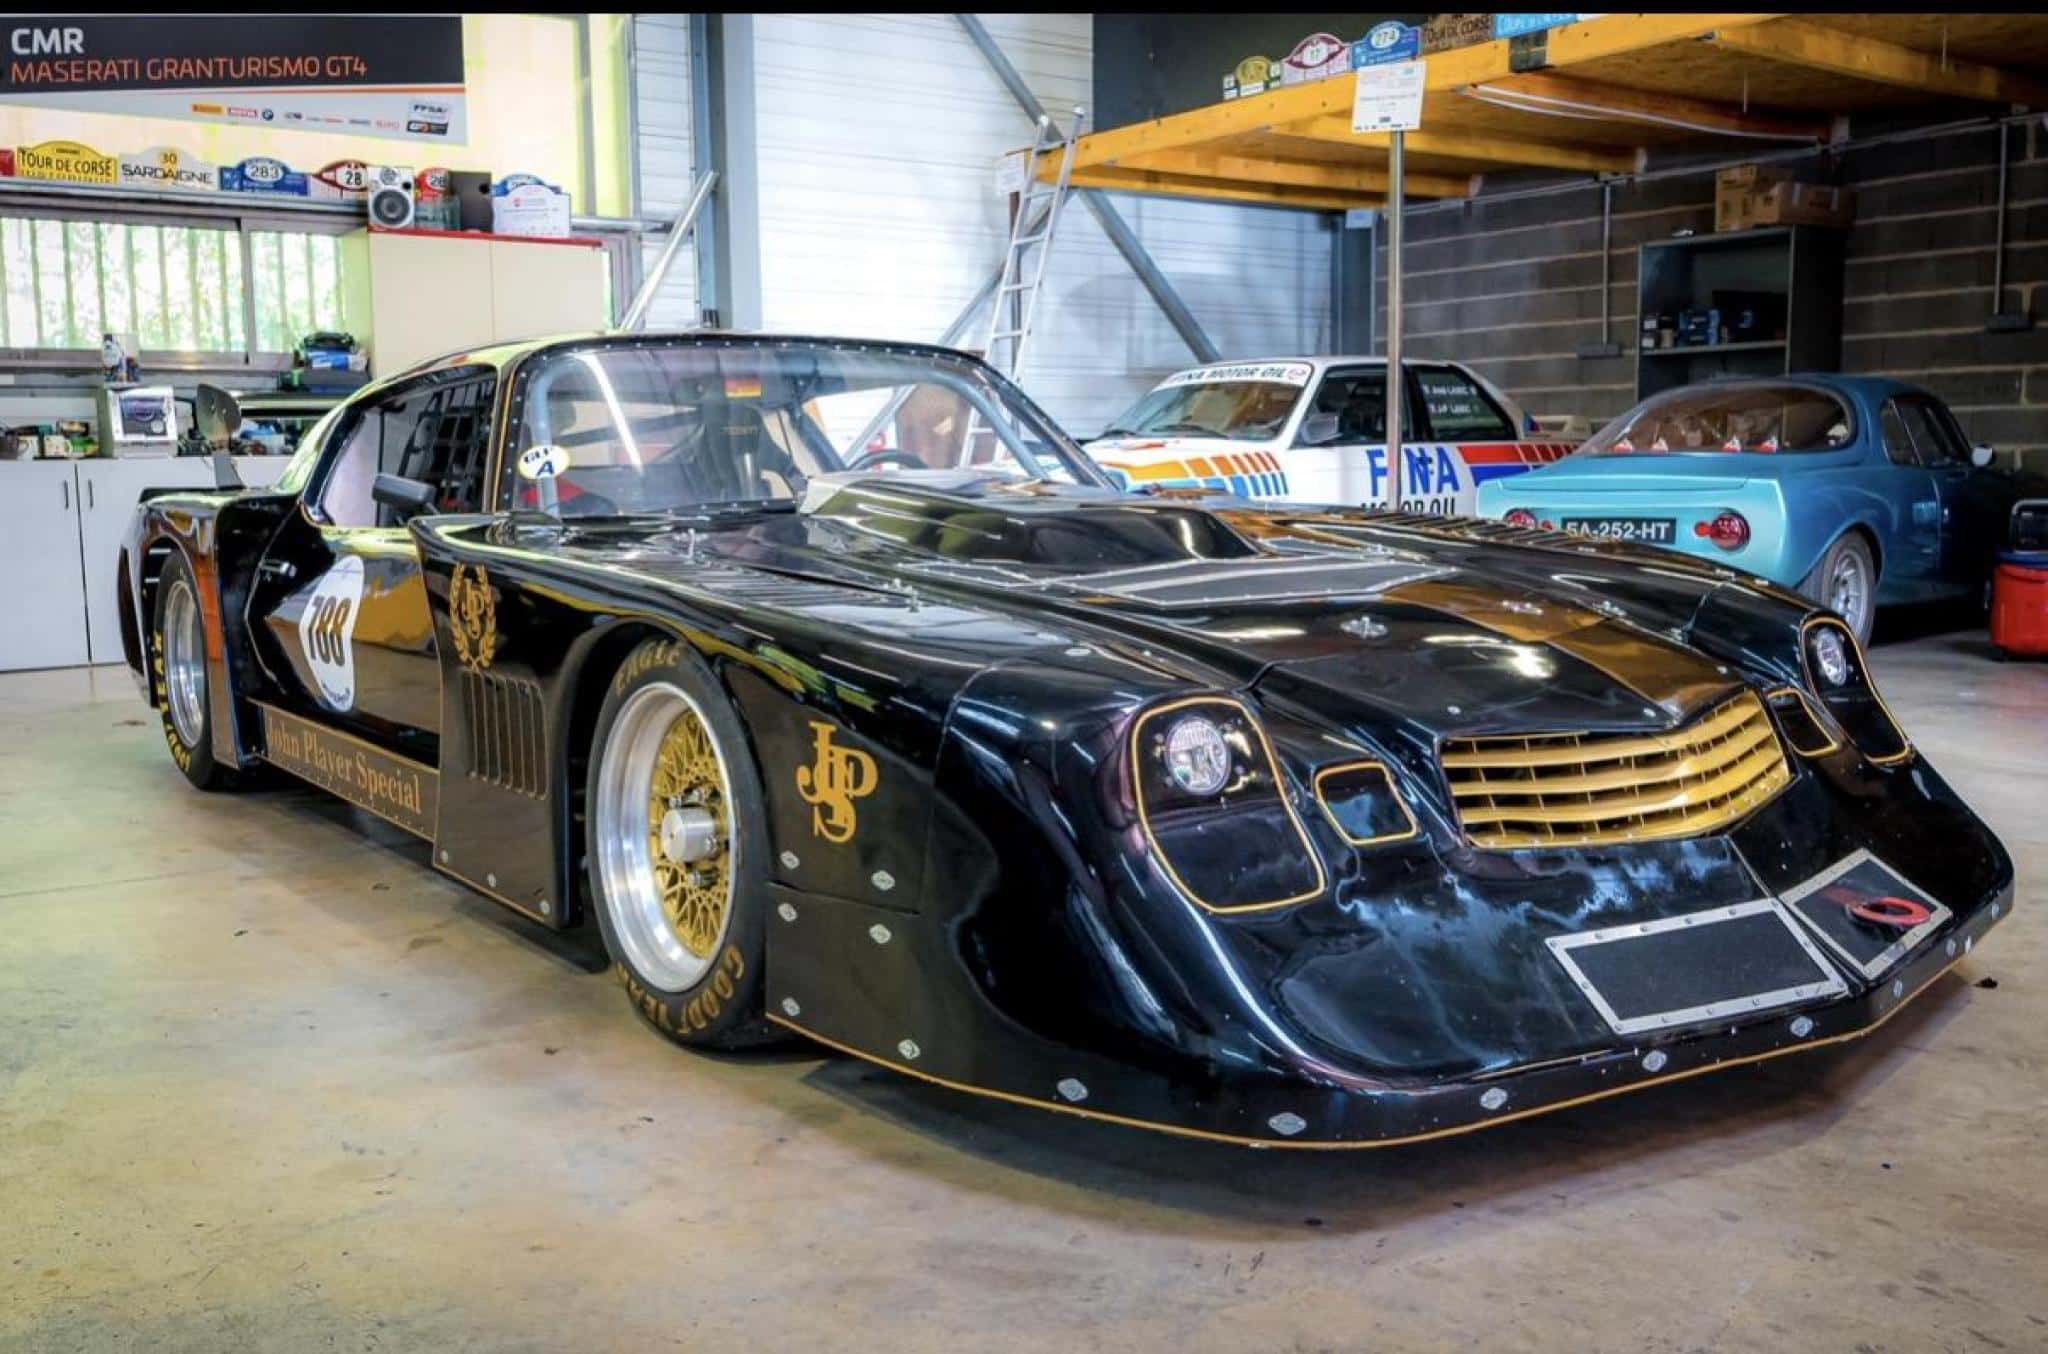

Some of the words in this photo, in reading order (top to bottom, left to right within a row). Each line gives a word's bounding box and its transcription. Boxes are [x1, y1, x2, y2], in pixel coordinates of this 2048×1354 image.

[11, 28, 84, 55] CMR
[11, 59, 139, 83] MASERATI
[146, 56, 320, 80] GRANTURISMO
[326, 55, 367, 77] GT4
[20, 149, 53, 170] TOUR
[55, 159, 71, 173] DE
[161, 152, 177, 164] 30
[121, 163, 213, 185] SARDAIGNE
[250, 164, 279, 179] 283
[537, 460, 553, 477] A
[1366, 447, 1460, 497] FNA
[267, 718, 300, 757] John
[303, 730, 351, 778] Player
[355, 751, 421, 815] Special
